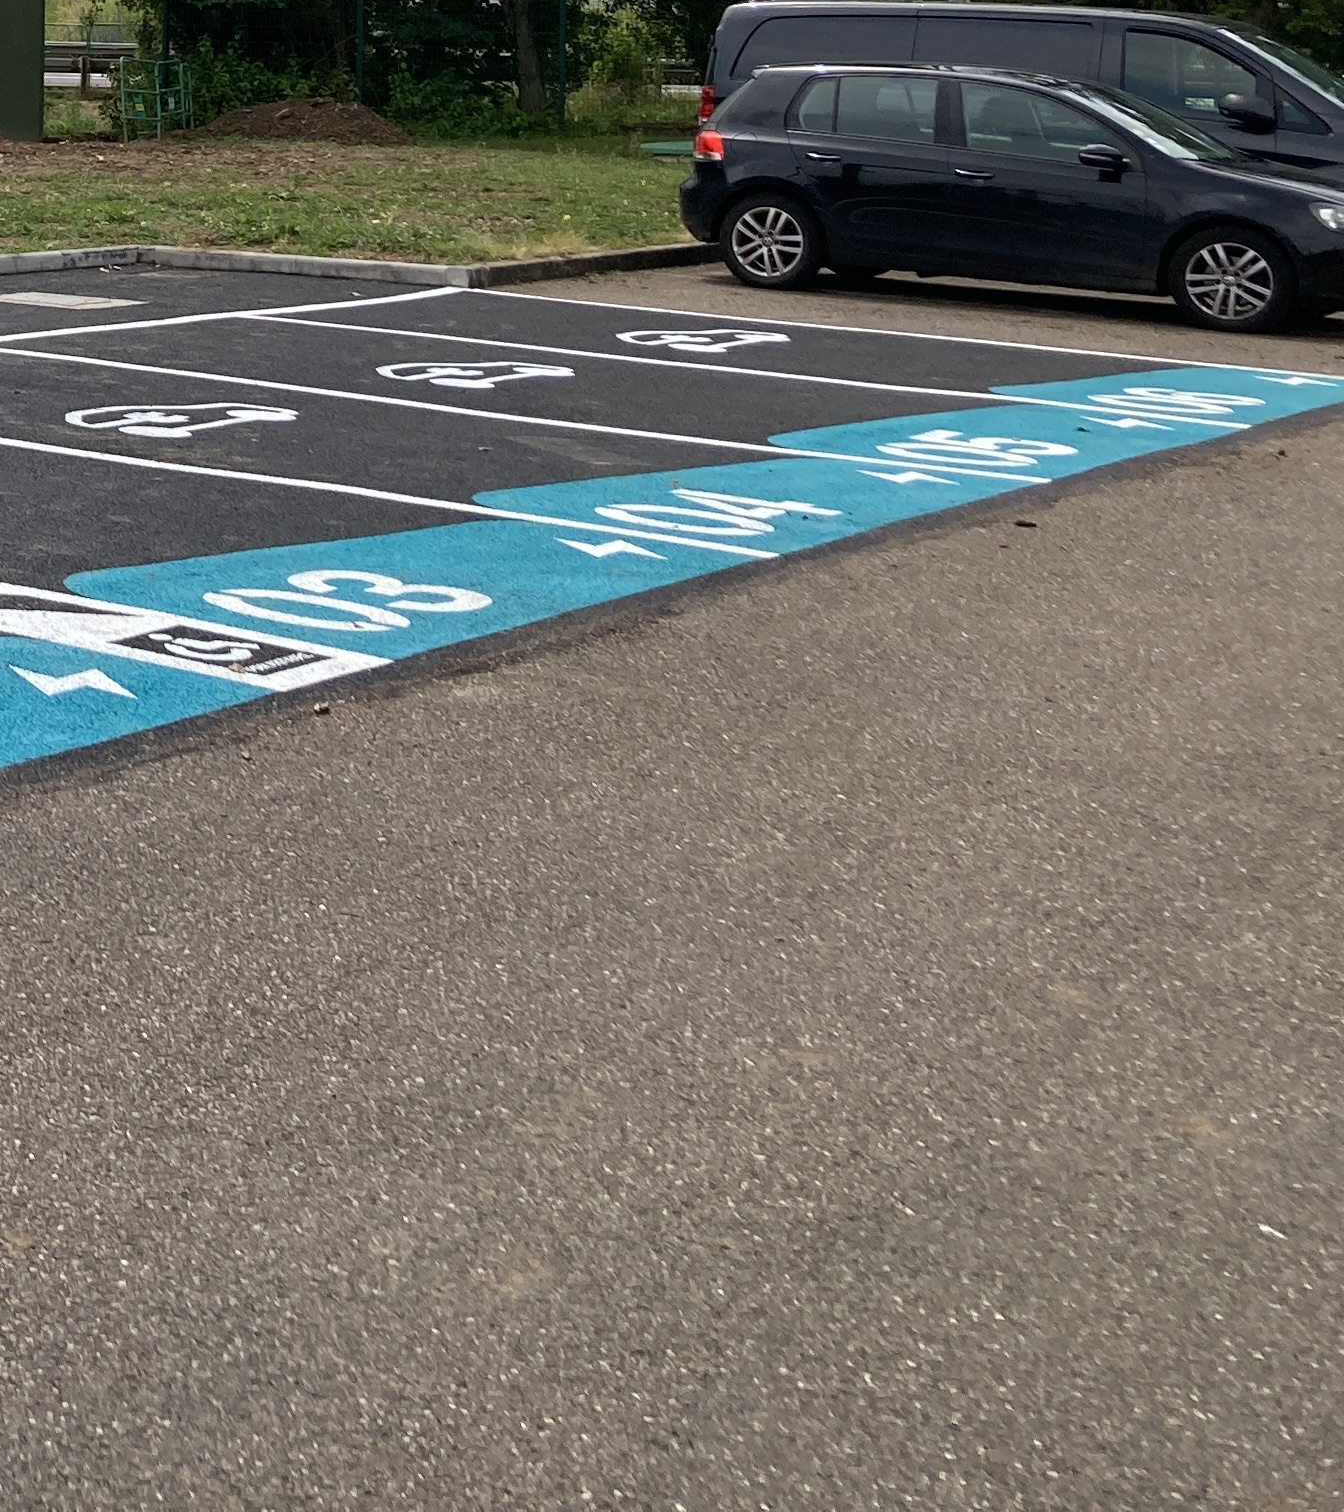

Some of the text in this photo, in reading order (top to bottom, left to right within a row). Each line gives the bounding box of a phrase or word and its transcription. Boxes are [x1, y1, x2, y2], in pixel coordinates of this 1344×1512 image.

[875, 429, 1080, 467] 05
[594, 488, 843, 536] 04
[202, 569, 493, 632] 03
